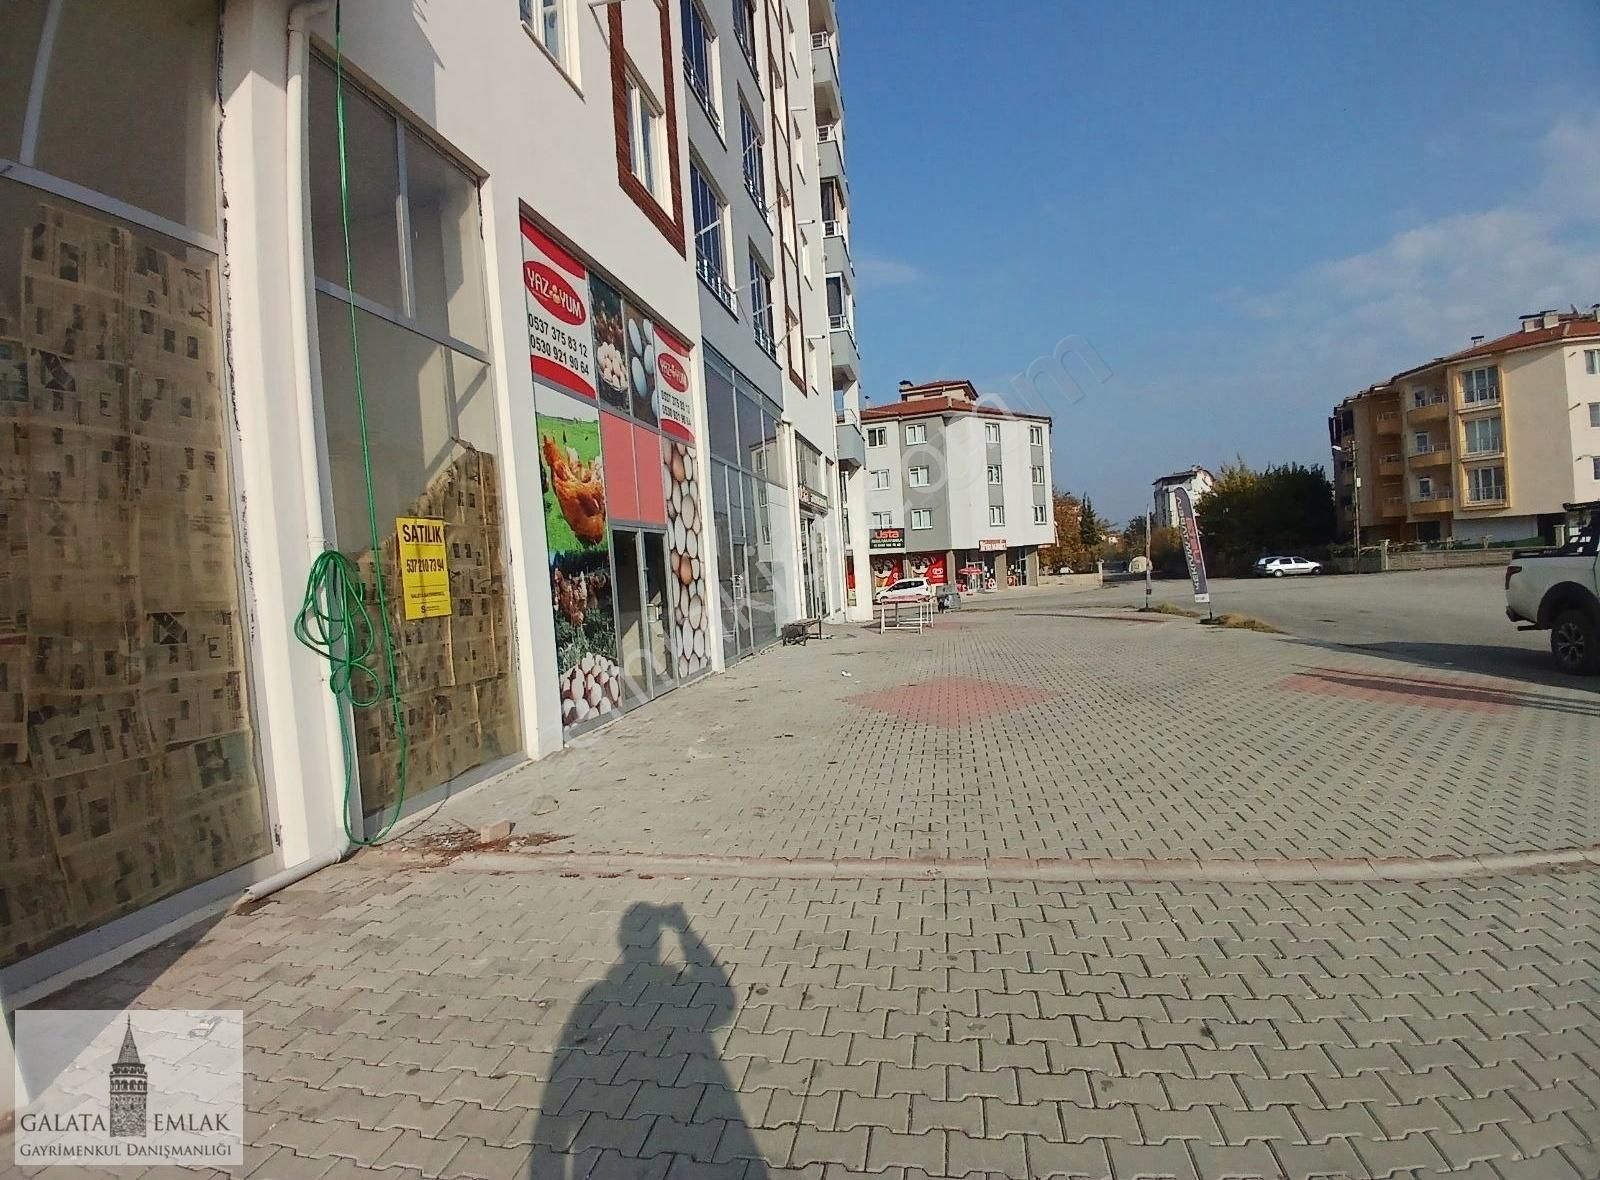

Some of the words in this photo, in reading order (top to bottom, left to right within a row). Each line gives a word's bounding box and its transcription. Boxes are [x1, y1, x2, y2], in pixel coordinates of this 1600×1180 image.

[527, 267, 551, 296] YAZ
[559, 289, 582, 319] YUM
[528, 313, 549, 336] 0537
[551, 326, 566, 346] 375
[567, 335, 577, 352] 83
[578, 343, 588, 358] 12
[530, 334, 551, 357] 0530
[553, 346, 567, 365] 921
[569, 355, 579, 371] 90
[580, 361, 589, 375] 64
[402, 524, 442, 543] SATILIK
[875, 530, 899, 539] Usta
[406, 558, 417, 573] 537
